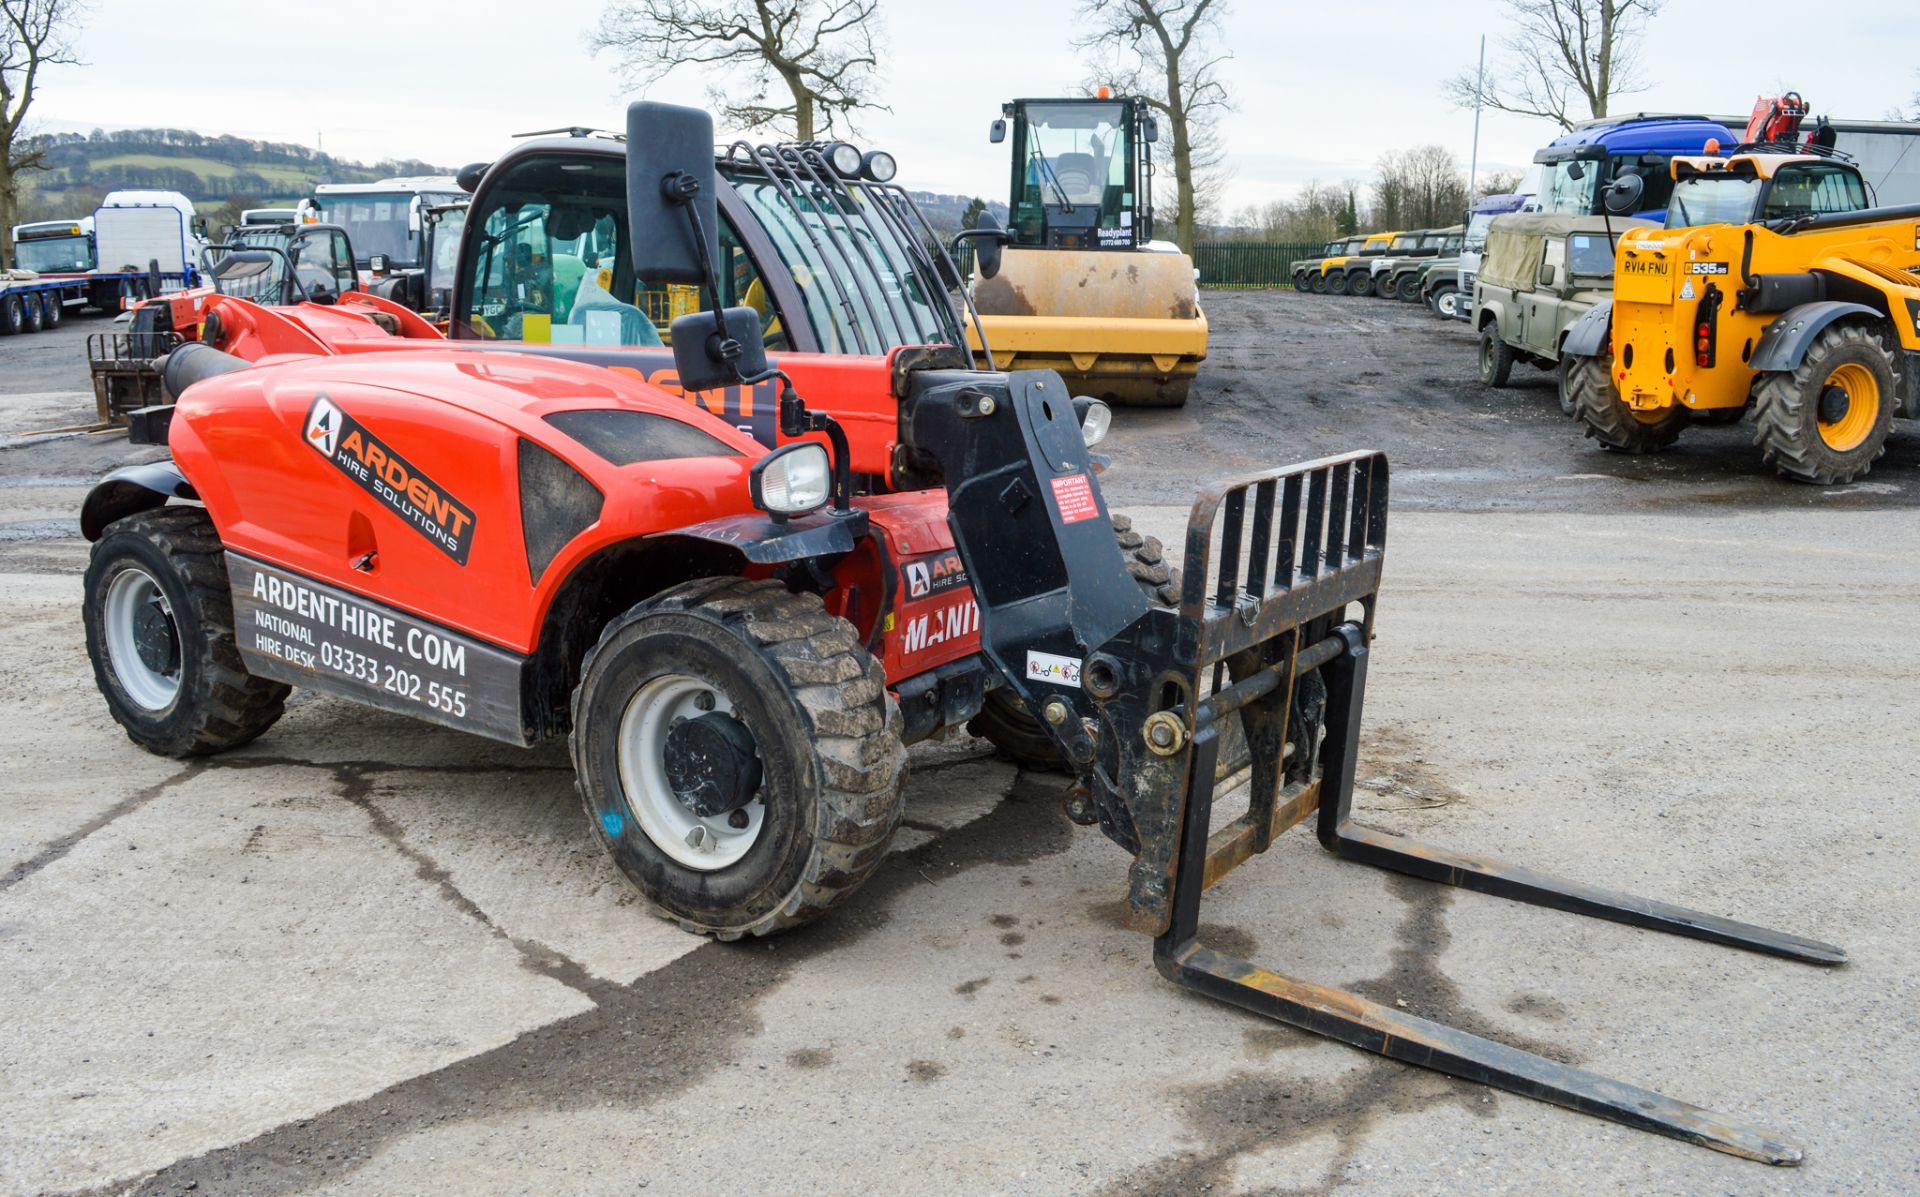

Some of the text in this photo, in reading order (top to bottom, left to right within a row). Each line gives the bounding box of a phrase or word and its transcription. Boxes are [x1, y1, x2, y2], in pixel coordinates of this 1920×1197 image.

[1098, 227, 1131, 238] Readyplant
[1624, 261, 1668, 274] RV14 FNU
[337, 451, 458, 551] HIRE SOLUTIONS
[341, 430, 471, 538] ARDENT
[1053, 476, 1087, 488] IMPORTANT
[932, 576, 953, 590] HIRE
[253, 572, 465, 677] ARDENTHIRE.COM
[255, 609, 316, 647] NATIONAL
[904, 599, 980, 655] MANIT
[255, 633, 316, 672] HIRE DESK
[321, 641, 466, 718] 03333 202 555
